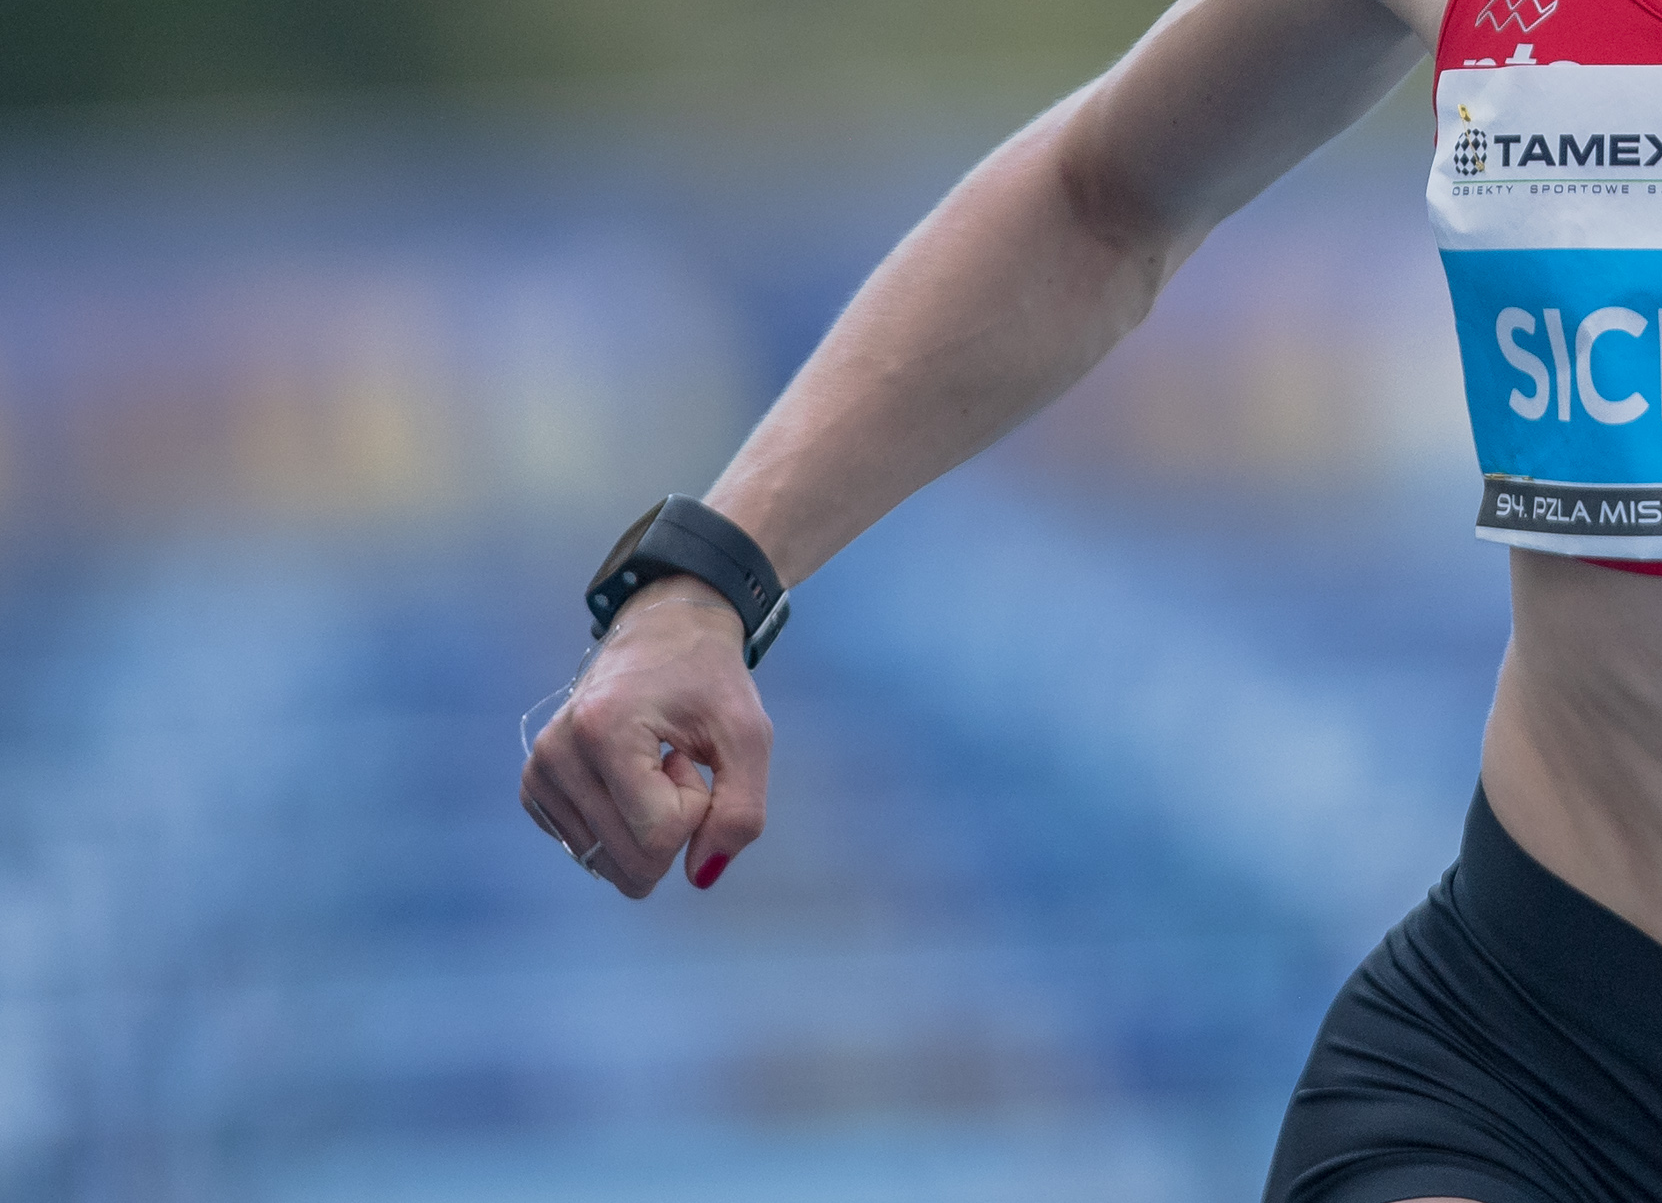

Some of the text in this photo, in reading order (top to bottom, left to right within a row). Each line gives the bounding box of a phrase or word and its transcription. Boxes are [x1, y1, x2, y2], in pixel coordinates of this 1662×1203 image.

[1452, 185, 1514, 196] OBIEKTY
[1530, 184, 1630, 194] SPORTOWE
[1496, 493, 1528, 518] 94.
[1532, 496, 1592, 524] PZLA
